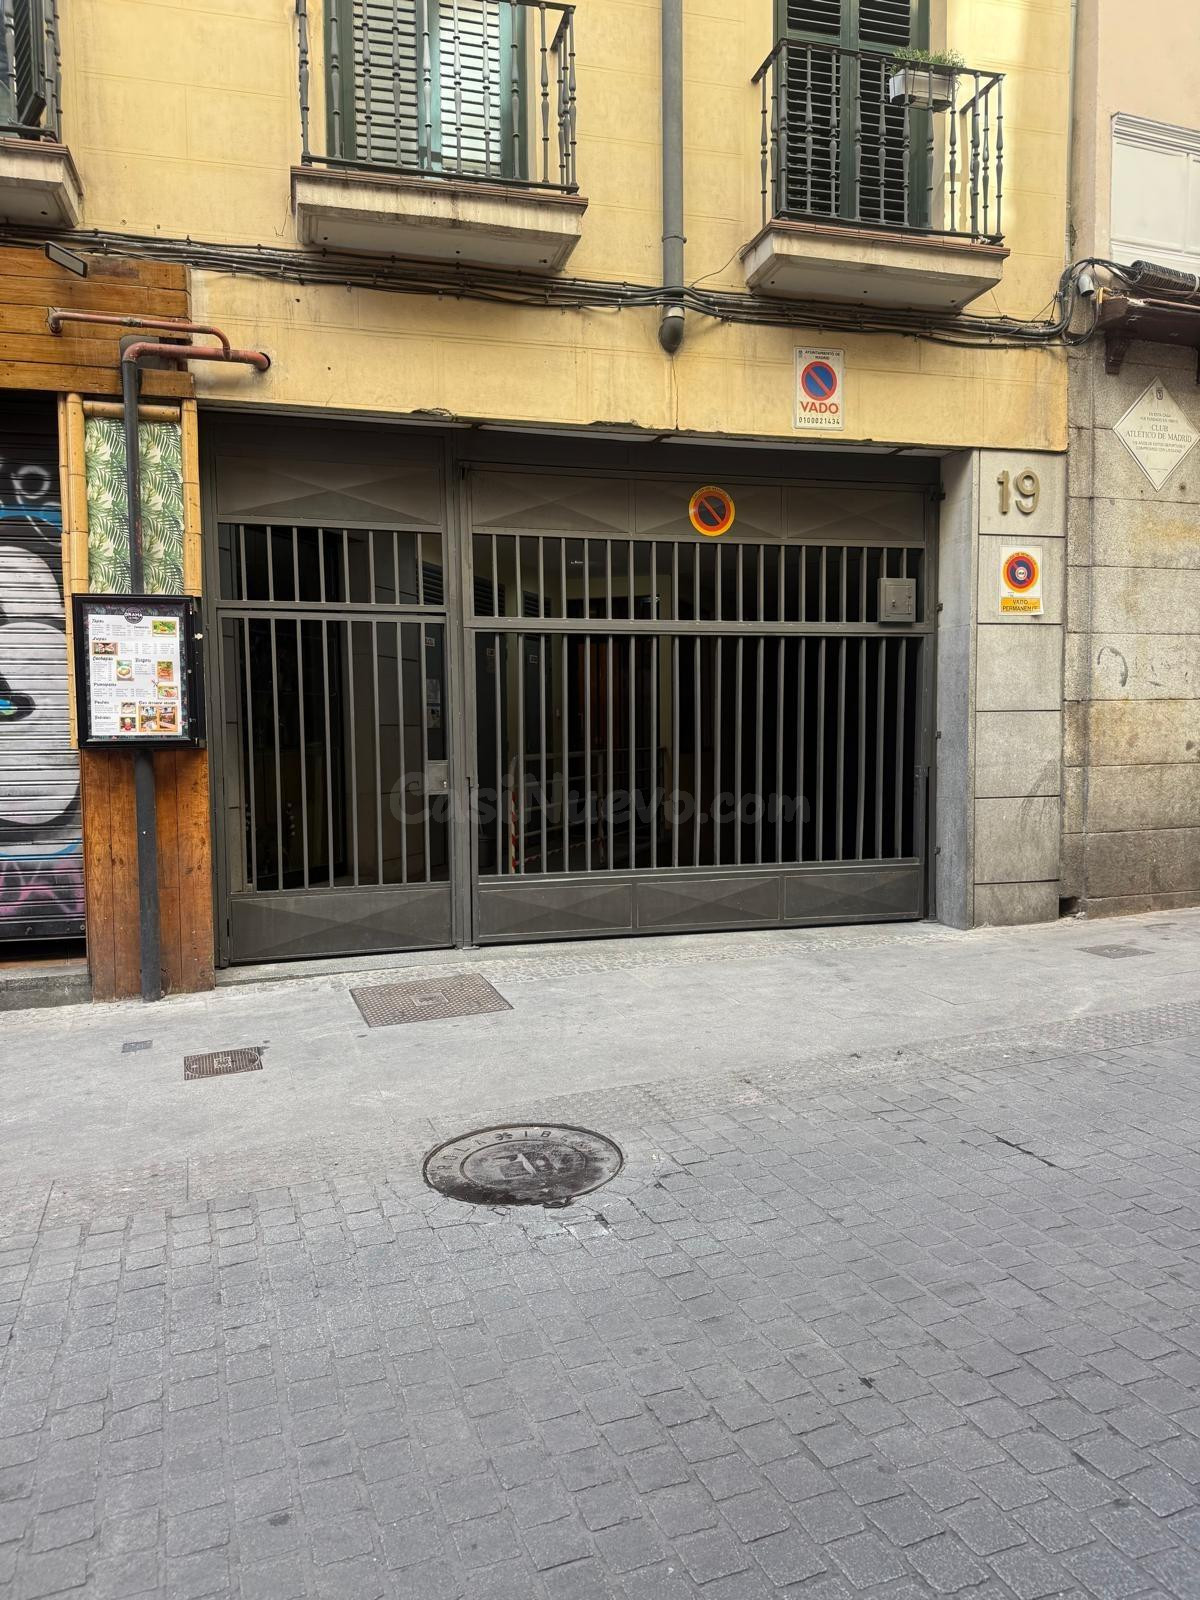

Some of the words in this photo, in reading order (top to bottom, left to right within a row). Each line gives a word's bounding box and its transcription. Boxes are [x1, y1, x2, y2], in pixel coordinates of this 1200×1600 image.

[800, 402, 839, 414] VADO
[1151, 424, 1169, 432] CLUB
[1157, 432, 1167, 440] DE
[1167, 433, 1192, 443] MADRID
[997, 470, 1041, 515] 19
